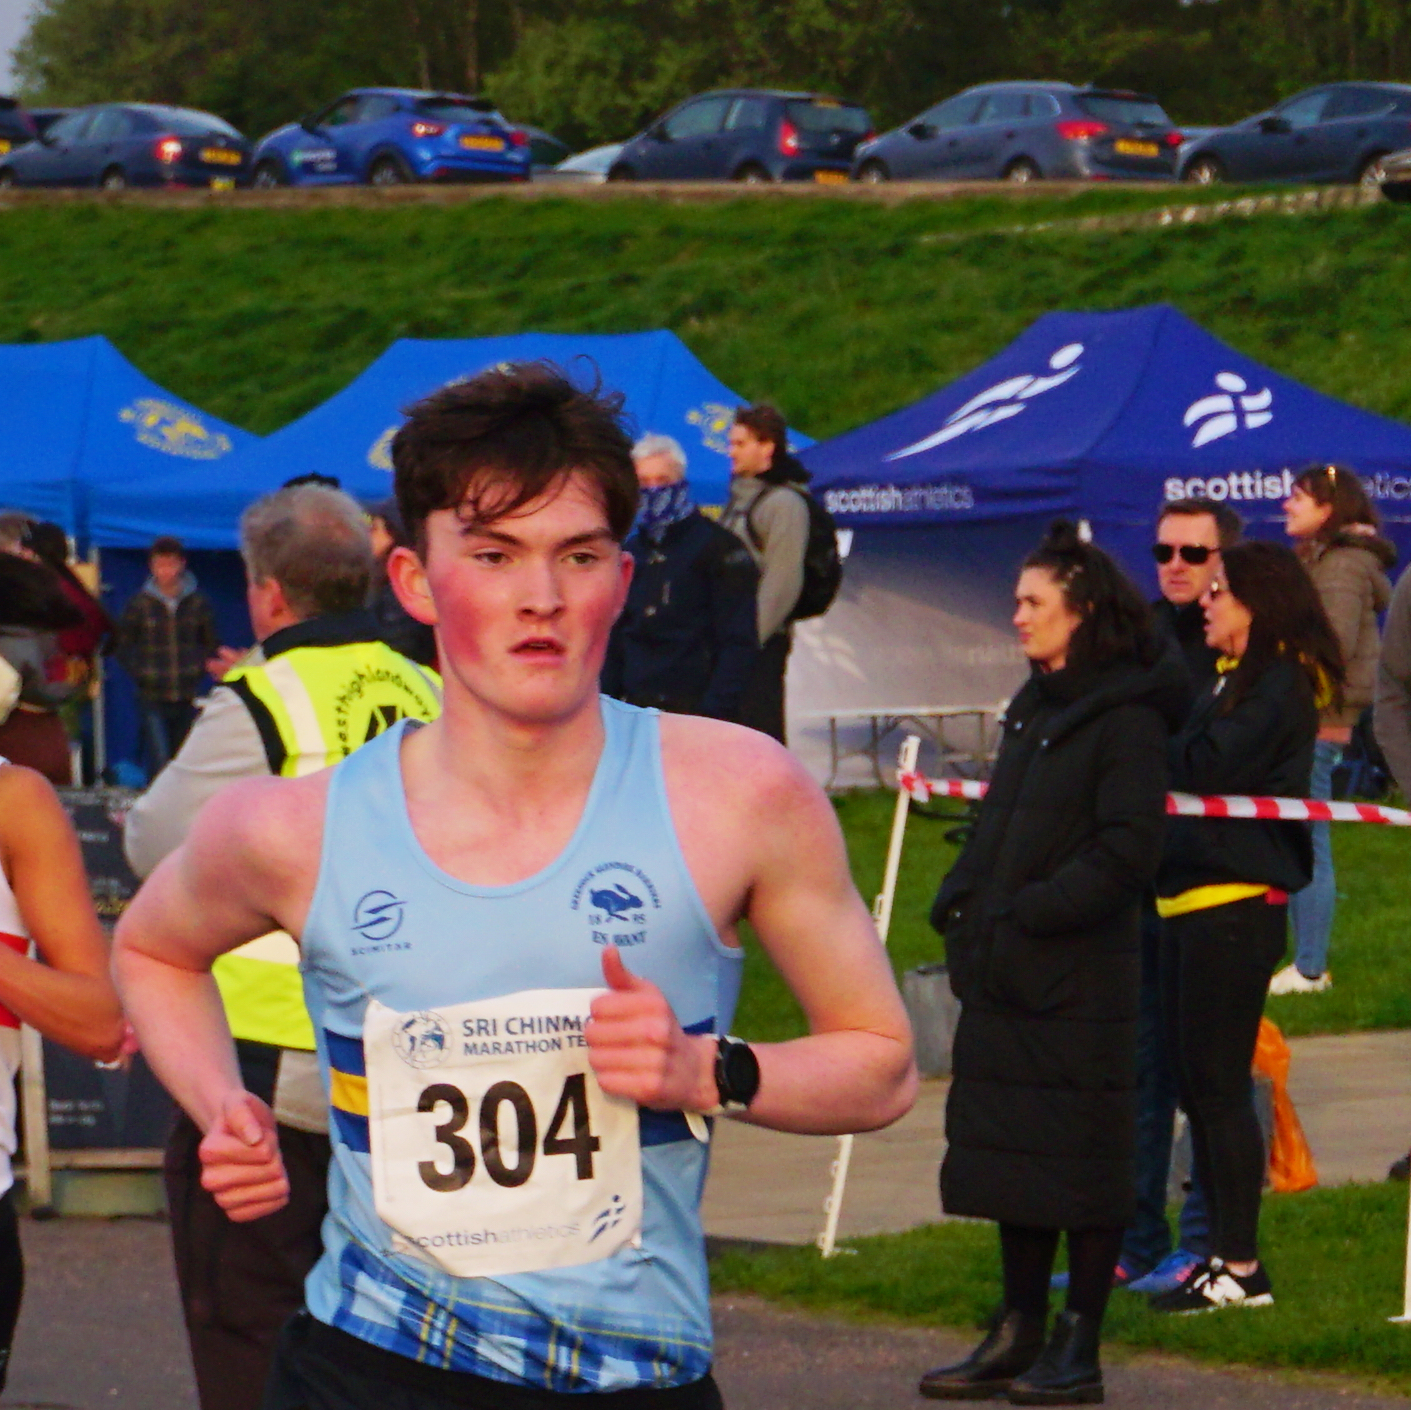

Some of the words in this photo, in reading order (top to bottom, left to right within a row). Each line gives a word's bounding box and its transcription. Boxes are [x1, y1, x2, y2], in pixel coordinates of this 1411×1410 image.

[462, 1018, 497, 1038] SRI
[506, 1014, 592, 1036] CHINM
[464, 1038, 563, 1057] MARATHON
[567, 1034, 591, 1049] TE
[416, 1072, 601, 1193] 304
